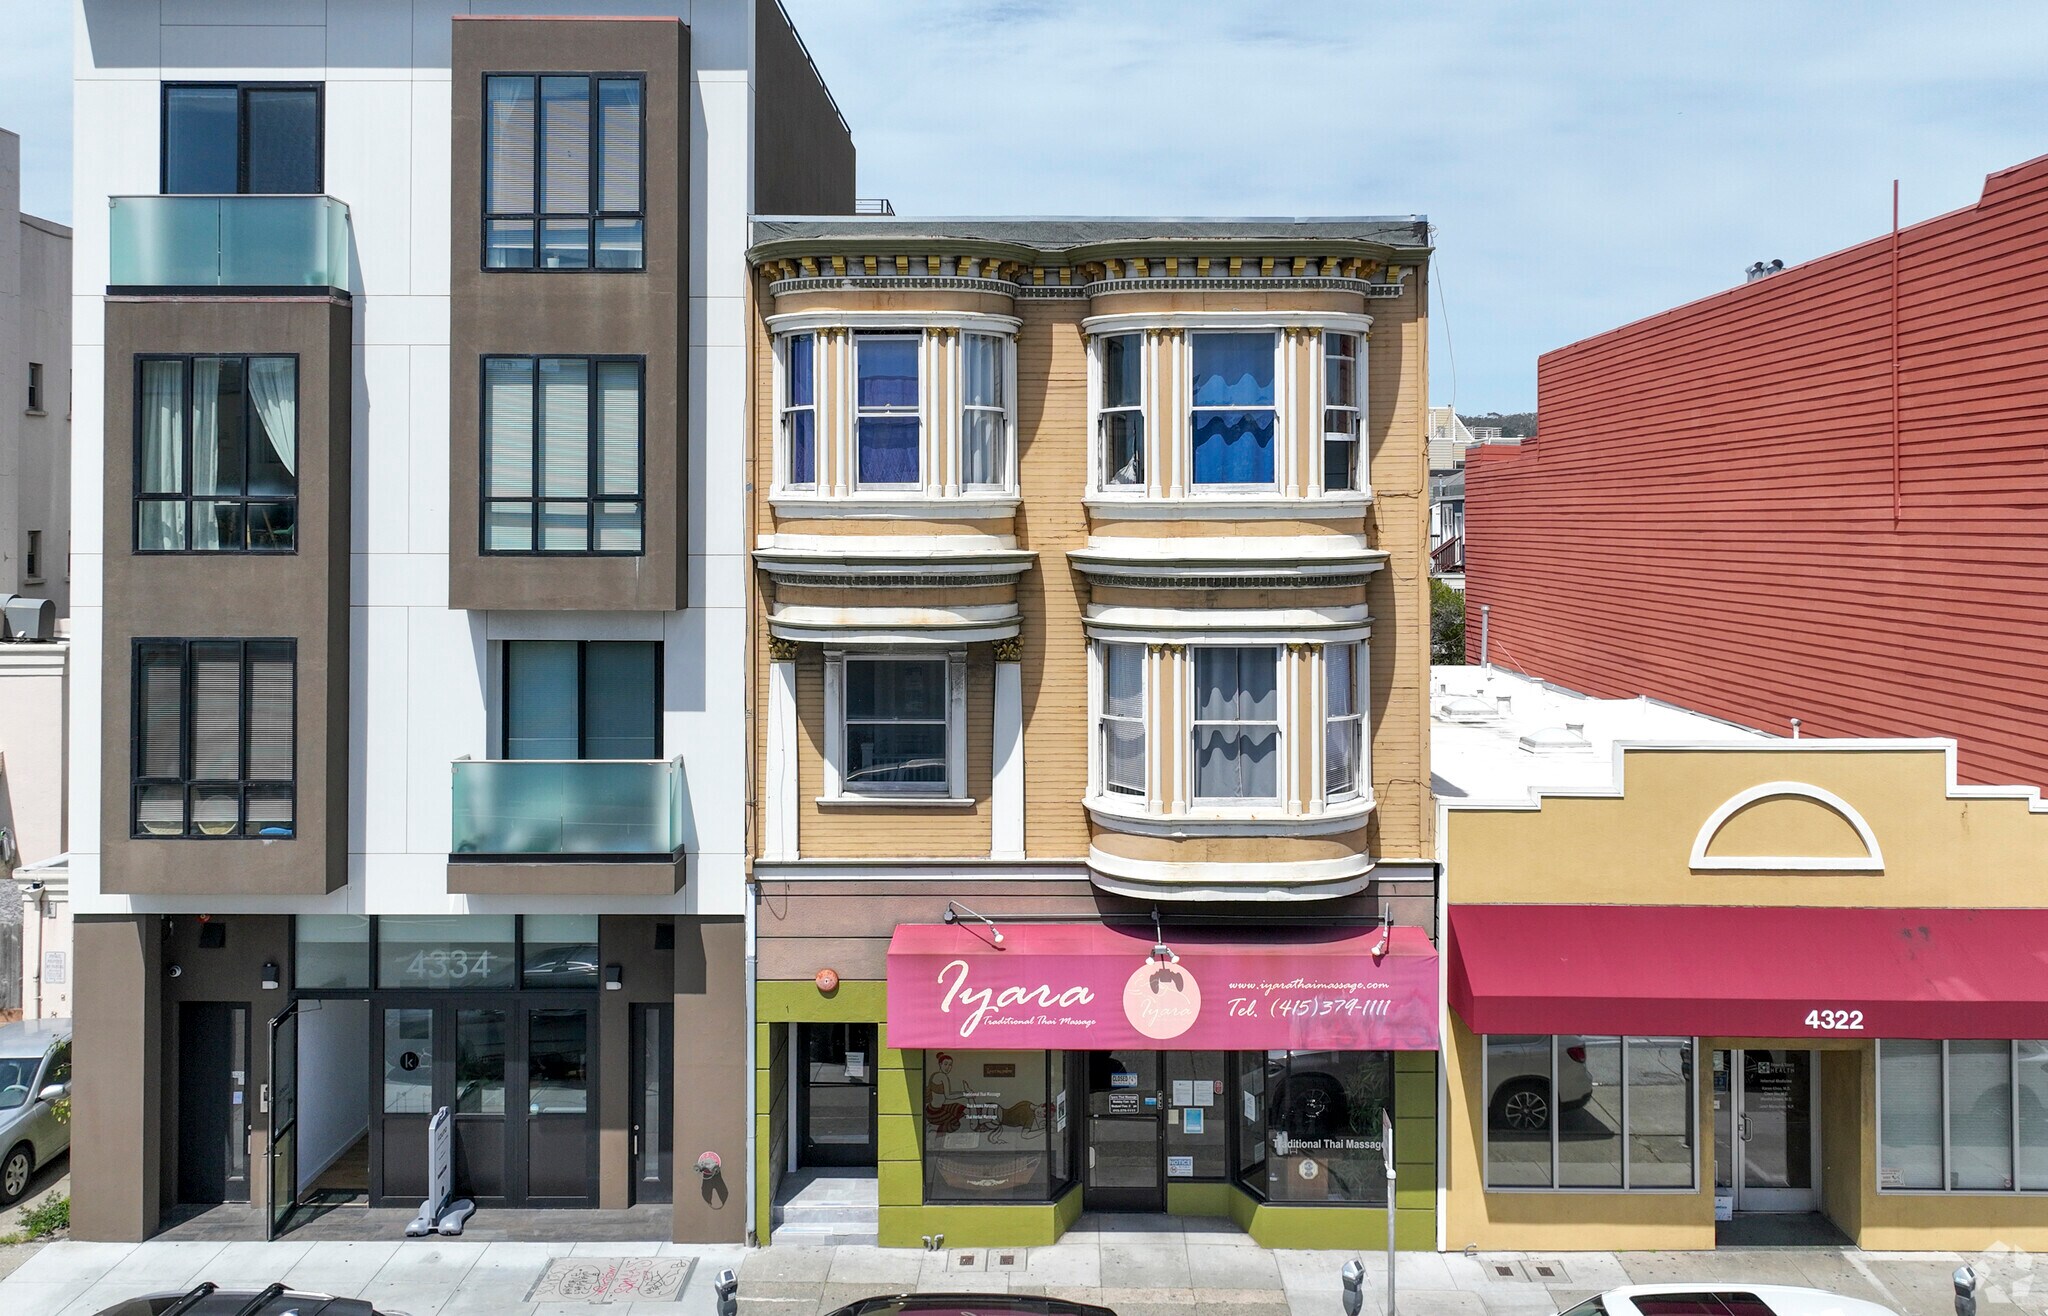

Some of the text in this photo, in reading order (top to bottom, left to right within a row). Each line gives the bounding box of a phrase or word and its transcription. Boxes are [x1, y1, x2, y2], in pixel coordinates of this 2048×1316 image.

[405, 949, 491, 979] 4334
[1228, 978, 1390, 996] www.iyarathaimassage.com
[937, 959, 1095, 1038] Iyara
[1227, 996, 1392, 1018] Tel. (415)379-1111
[983, 1014, 1096, 1029] Traditional Thai Massage
[1141, 998, 1192, 1027] Iyara
[1804, 1009, 1864, 1030] 4322
[1323, 1139, 1344, 1149] Thai
